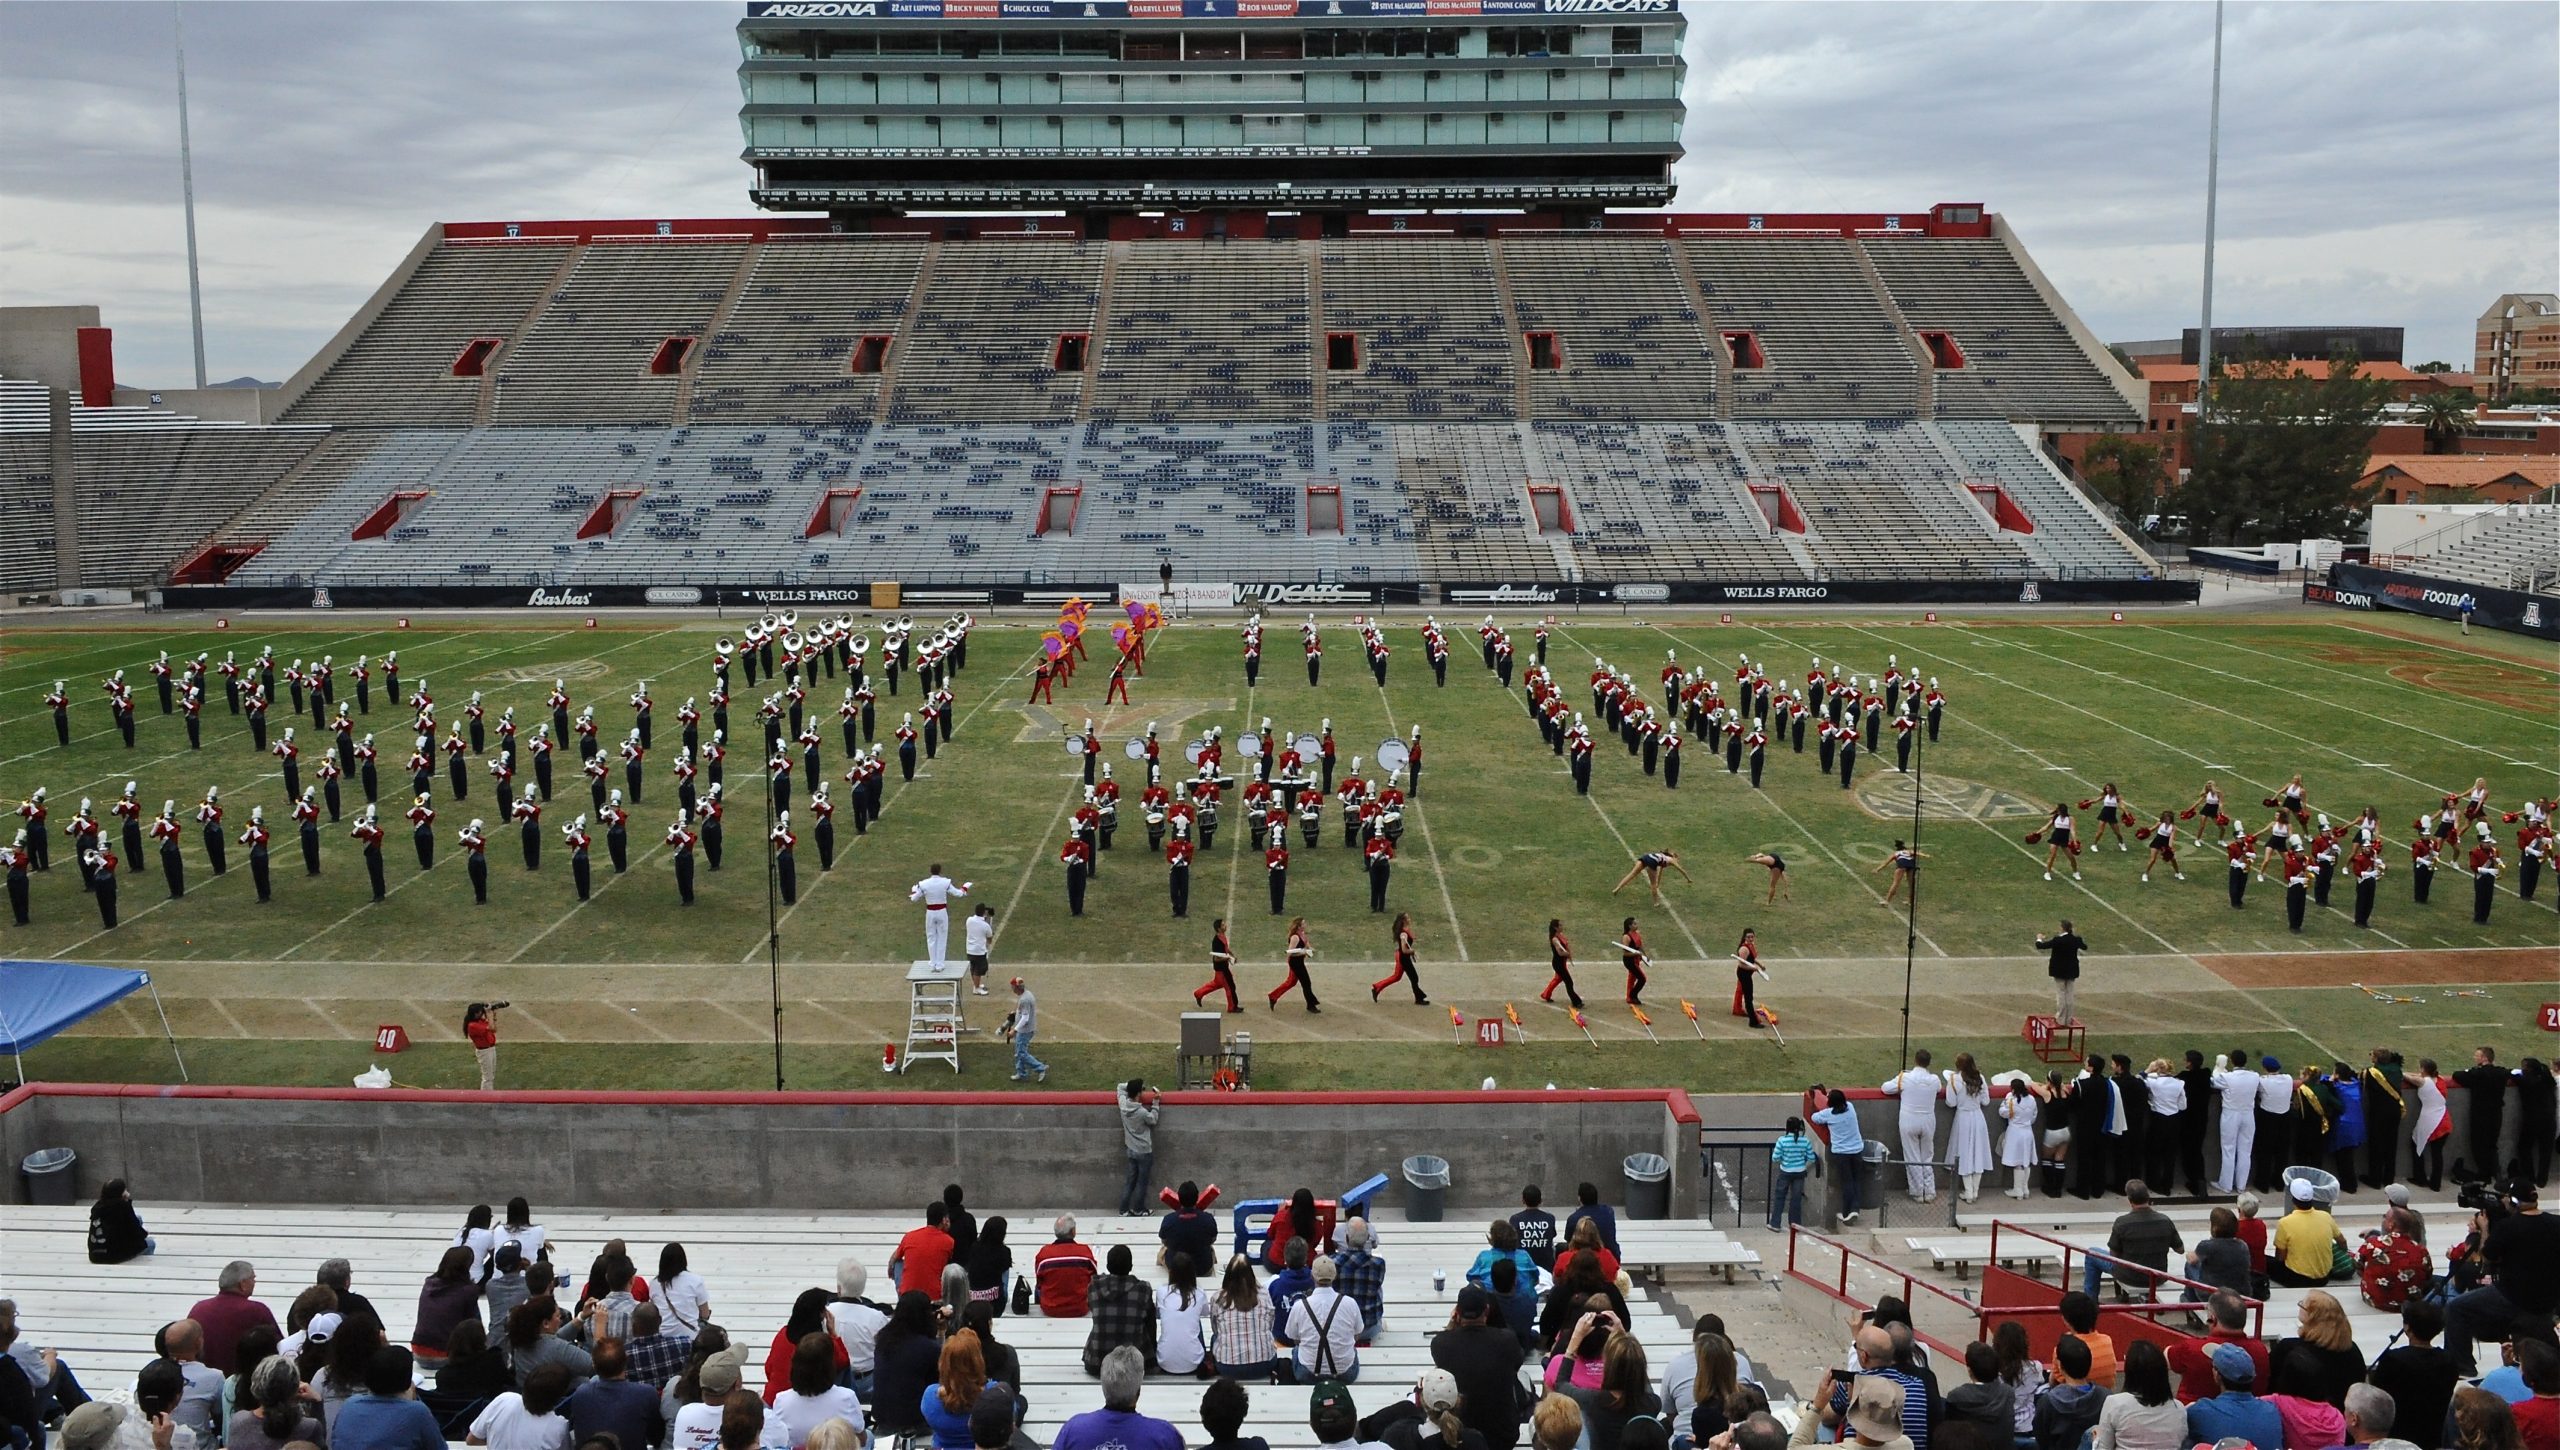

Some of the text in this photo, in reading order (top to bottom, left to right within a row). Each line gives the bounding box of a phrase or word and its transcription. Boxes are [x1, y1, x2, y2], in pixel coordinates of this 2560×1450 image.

[761, 3, 876, 17] ARIZONA
[891, 4, 941, 12] 22 ART LUPPINO
[953, 4, 972, 12] RICKY
[973, 4, 998, 12] HUNLEY
[1162, 5, 1182, 13] LEWIS
[1544, 0, 1671, 12] WILDCATS
[831, 225, 842, 234] 19
[1025, 223, 1038, 232] 20
[1172, 222, 1184, 231] 21
[1393, 221, 1406, 230] 22
[1589, 220, 1602, 230] 23
[1749, 221, 1762, 230] 24
[1886, 221, 1899, 230] 25
[508, 228, 518, 237] 17
[658, 226, 670, 235] 18
[151, 394, 161, 403] 16
[527, 588, 592, 605] Bashas'
[755, 590, 859, 601] WELLS FARGO
[1122, 590, 1156, 600] UNIVERSITY
[1197, 590, 1216, 600] BAND
[1217, 590, 1230, 600] DAY
[1723, 587, 1828, 598] WELLS FARGO
[2547, 1008, 2560, 1026] 2
[1481, 1023, 1499, 1042] 40
[377, 1028, 396, 1048] 40
[1519, 1221, 1549, 1230] BAND
[1523, 1230, 1546, 1239] DAY
[1520, 1239, 1548, 1248] STAFF
